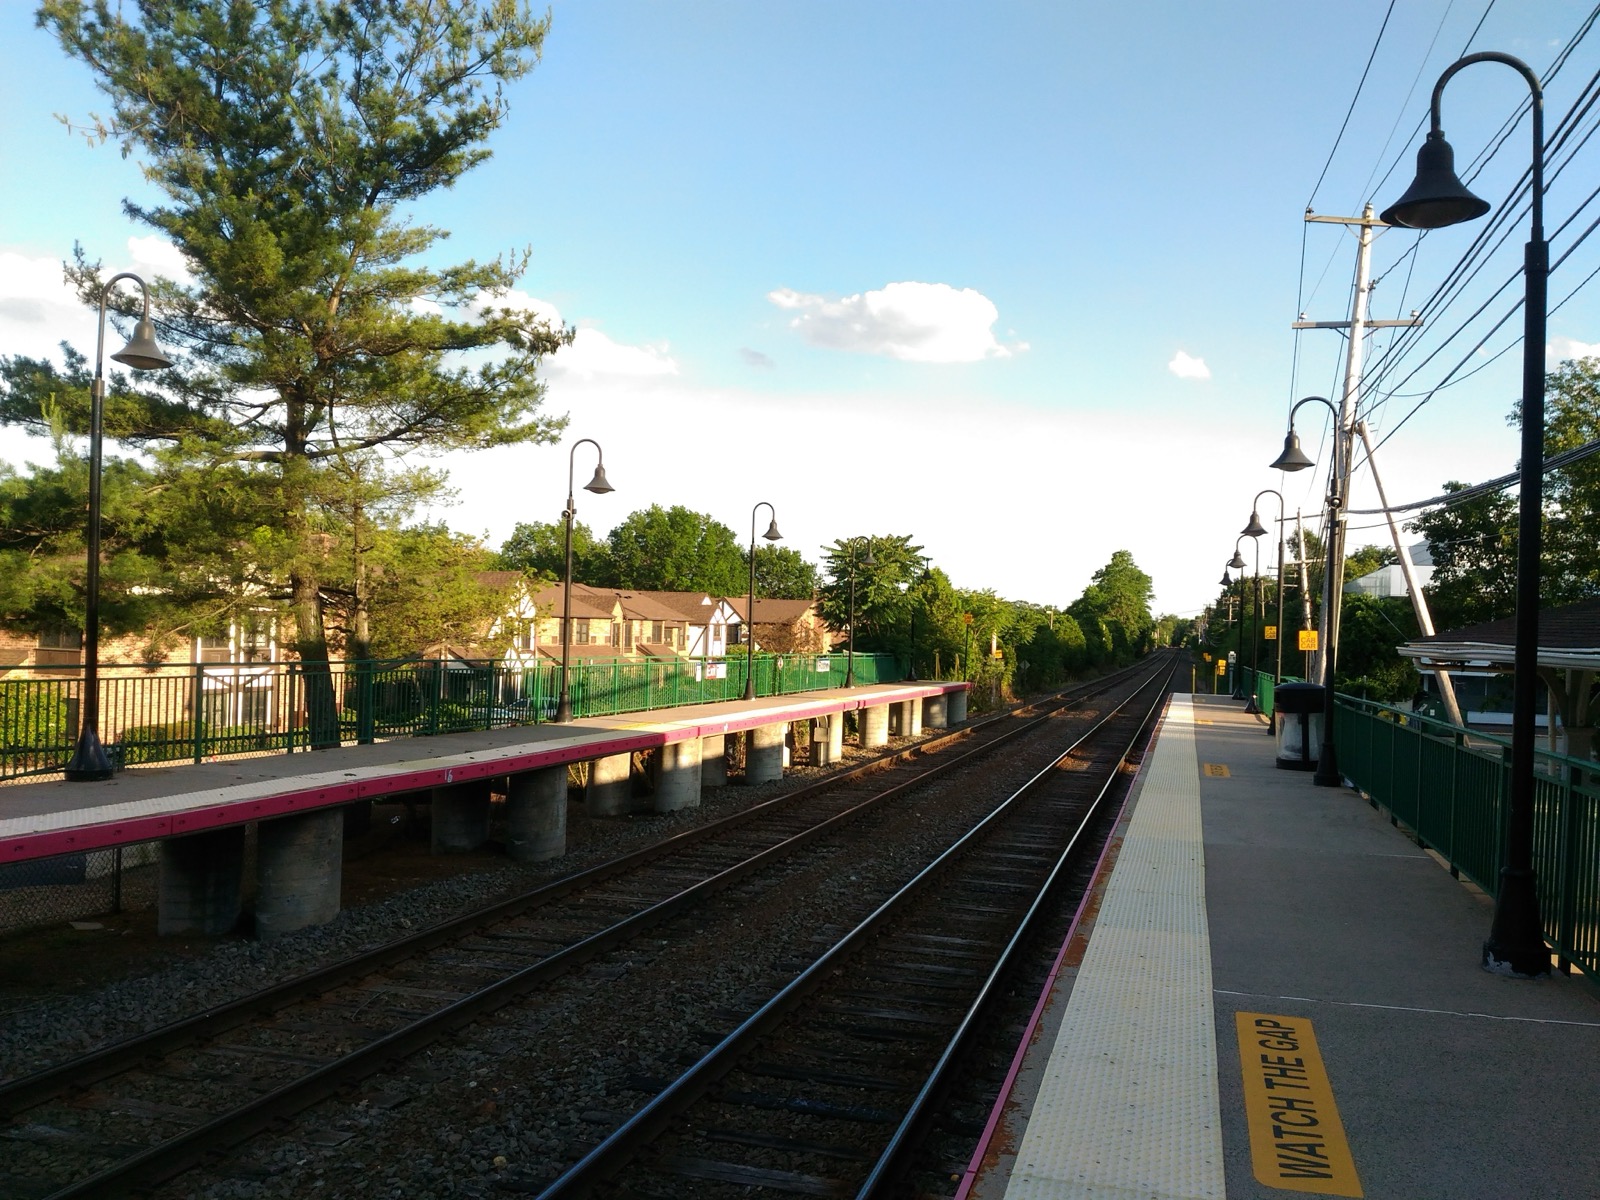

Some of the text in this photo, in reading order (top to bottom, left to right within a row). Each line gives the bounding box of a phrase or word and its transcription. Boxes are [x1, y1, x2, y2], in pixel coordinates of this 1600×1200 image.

[1254, 1018, 1333, 1179] WATCH THE GAP
